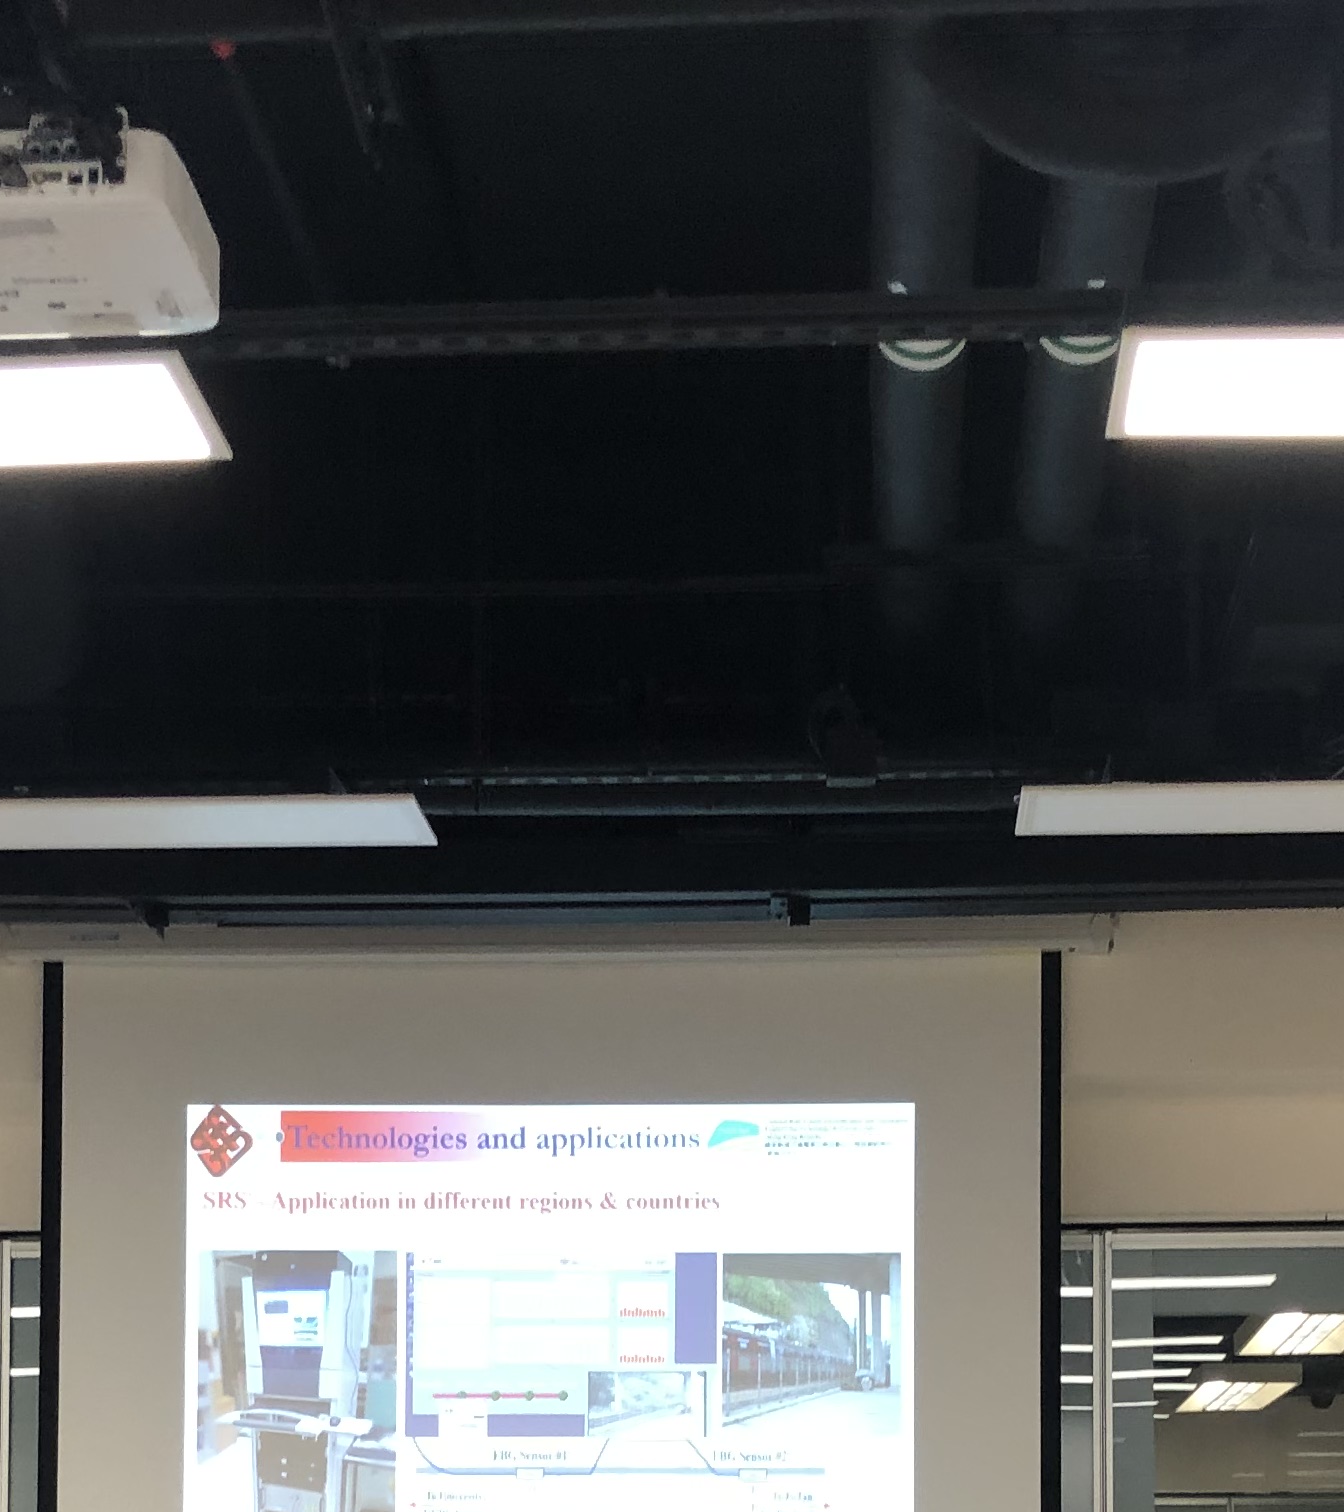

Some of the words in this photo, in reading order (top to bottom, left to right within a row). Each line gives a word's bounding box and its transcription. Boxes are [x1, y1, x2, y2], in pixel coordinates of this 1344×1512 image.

[287, 1124, 468, 1158] Technologies
[476, 1126, 527, 1150] and
[536, 1126, 701, 1158] applications
[202, 1191, 248, 1210] SRS
[273, 1191, 390, 1216] Application
[398, 1191, 417, 1210] in
[423, 1191, 512, 1210] different
[519, 1191, 594, 1216] regions
[599, 1191, 619, 1211] &
[625, 1191, 721, 1210] countries
